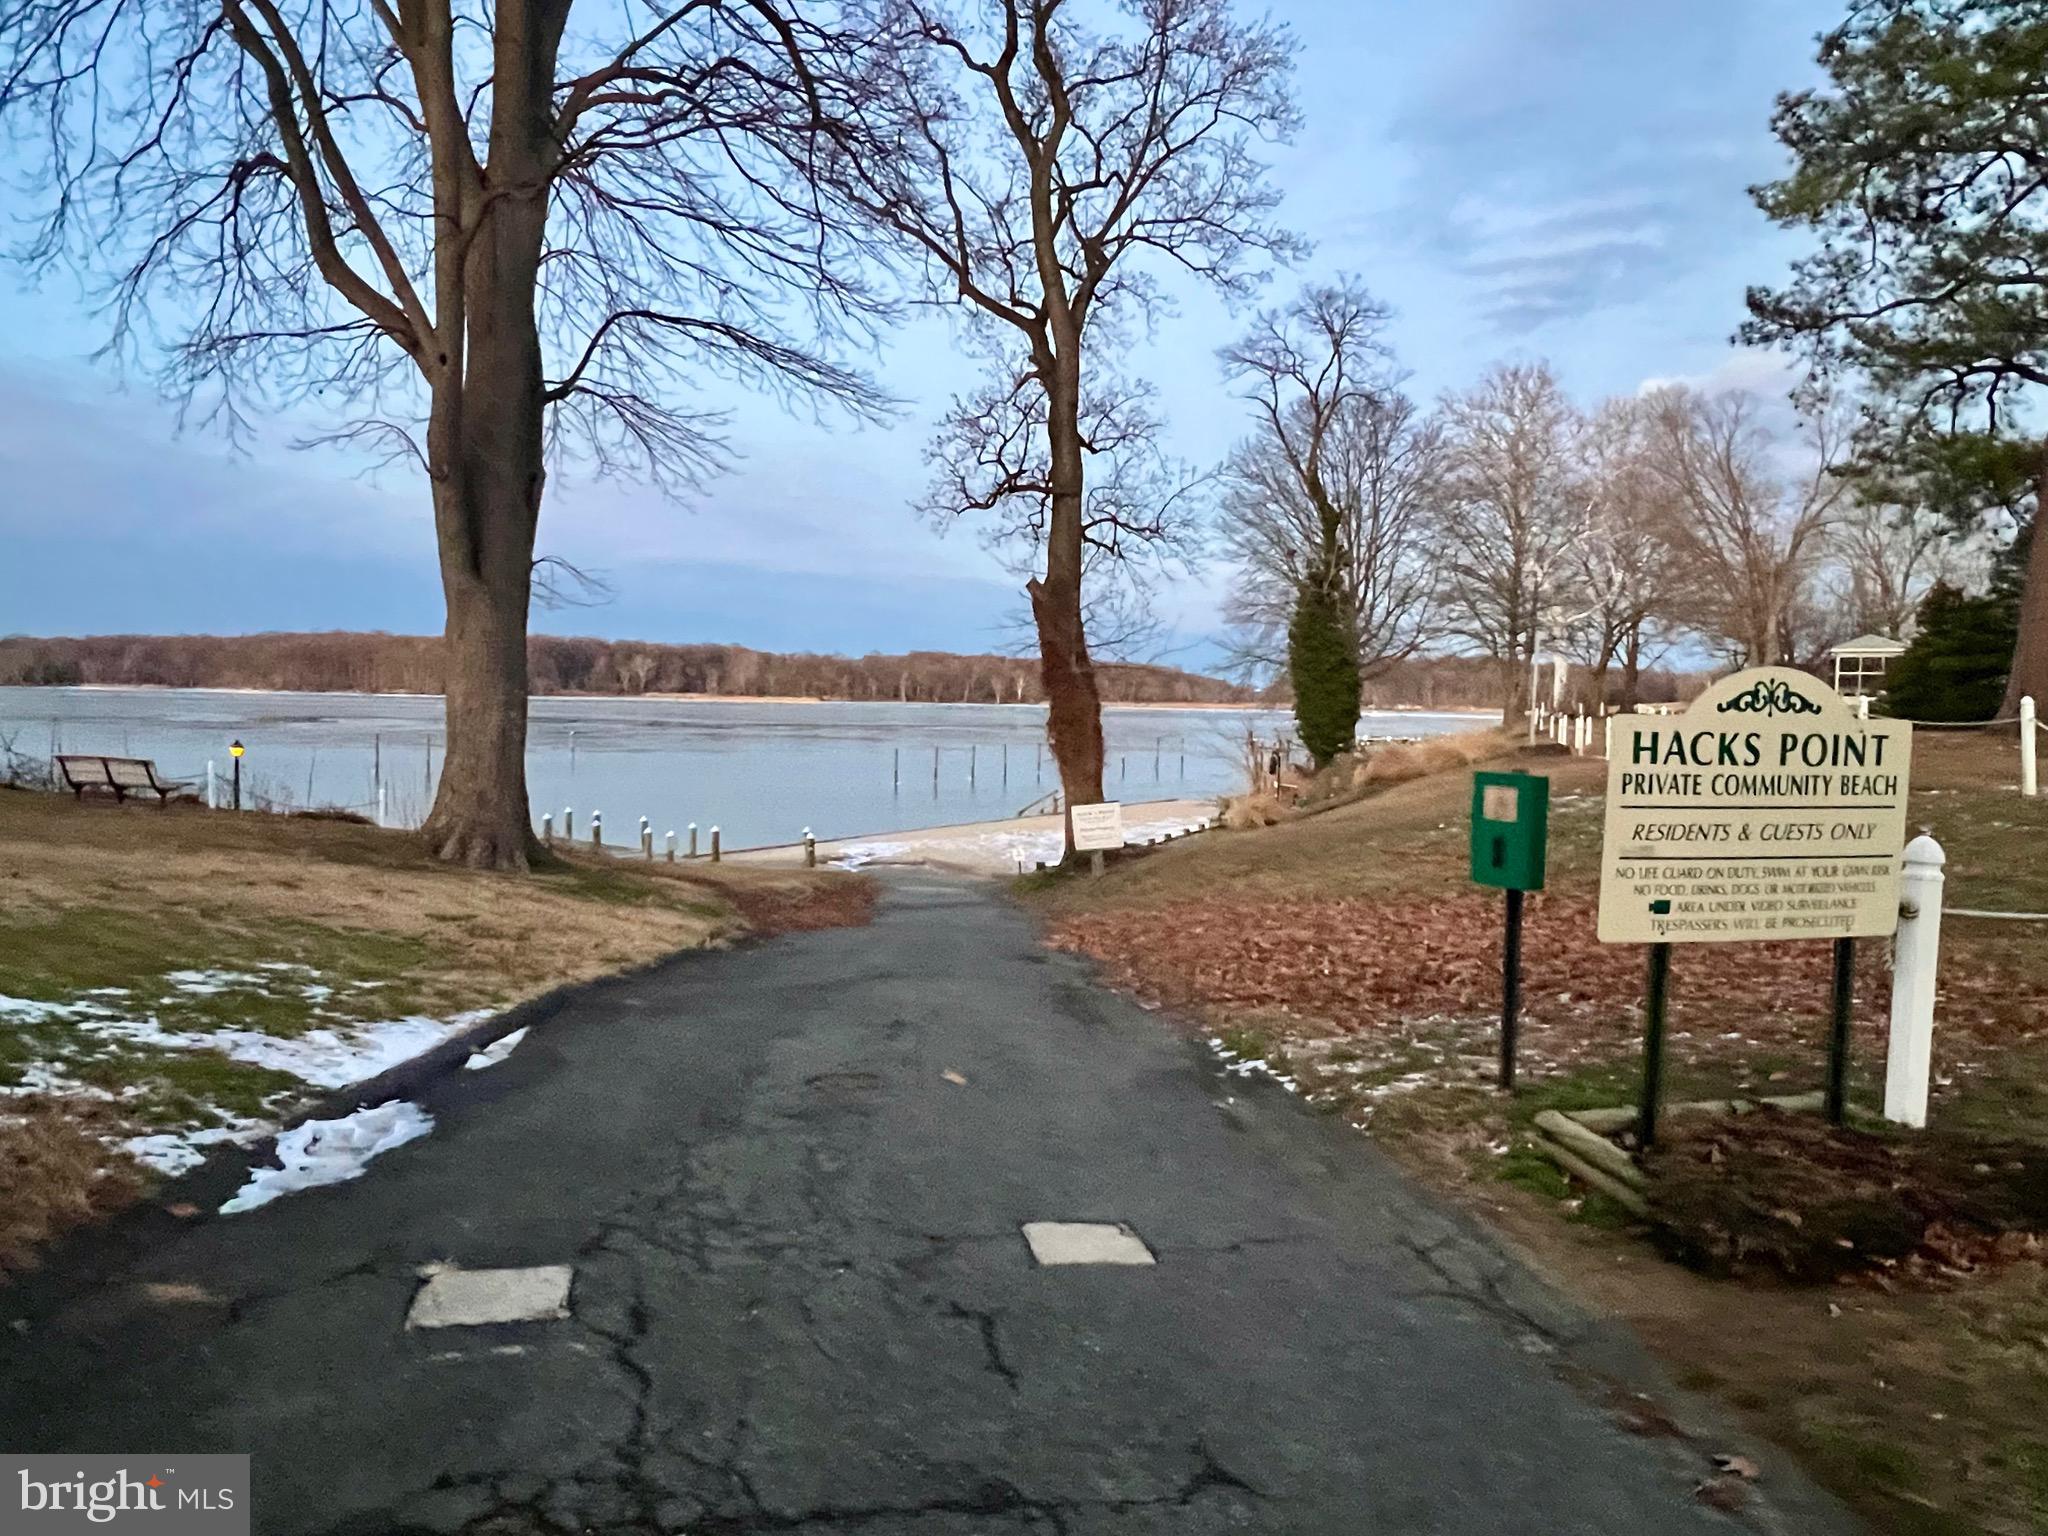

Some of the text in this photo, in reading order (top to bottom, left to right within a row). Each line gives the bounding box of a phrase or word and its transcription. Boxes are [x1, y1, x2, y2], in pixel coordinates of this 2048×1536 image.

[1632, 730, 1890, 767] HACKS POINT
[1621, 773, 1897, 796] PRIVATE COMMUNITY BEACH
[1632, 823, 1877, 841] RESIDENTS & GUESTS ONLY
[1616, 867, 1635, 879] NO
[1639, 867, 1659, 879] LIFE
[1662, 867, 1703, 879] GUARD
[1706, 867, 1725, 879] ON
[1794, 865, 1808, 878] AT
[1811, 865, 1838, 878] YOUR
[1633, 884, 1651, 896] NO
[1677, 901, 1704, 912] AREA
